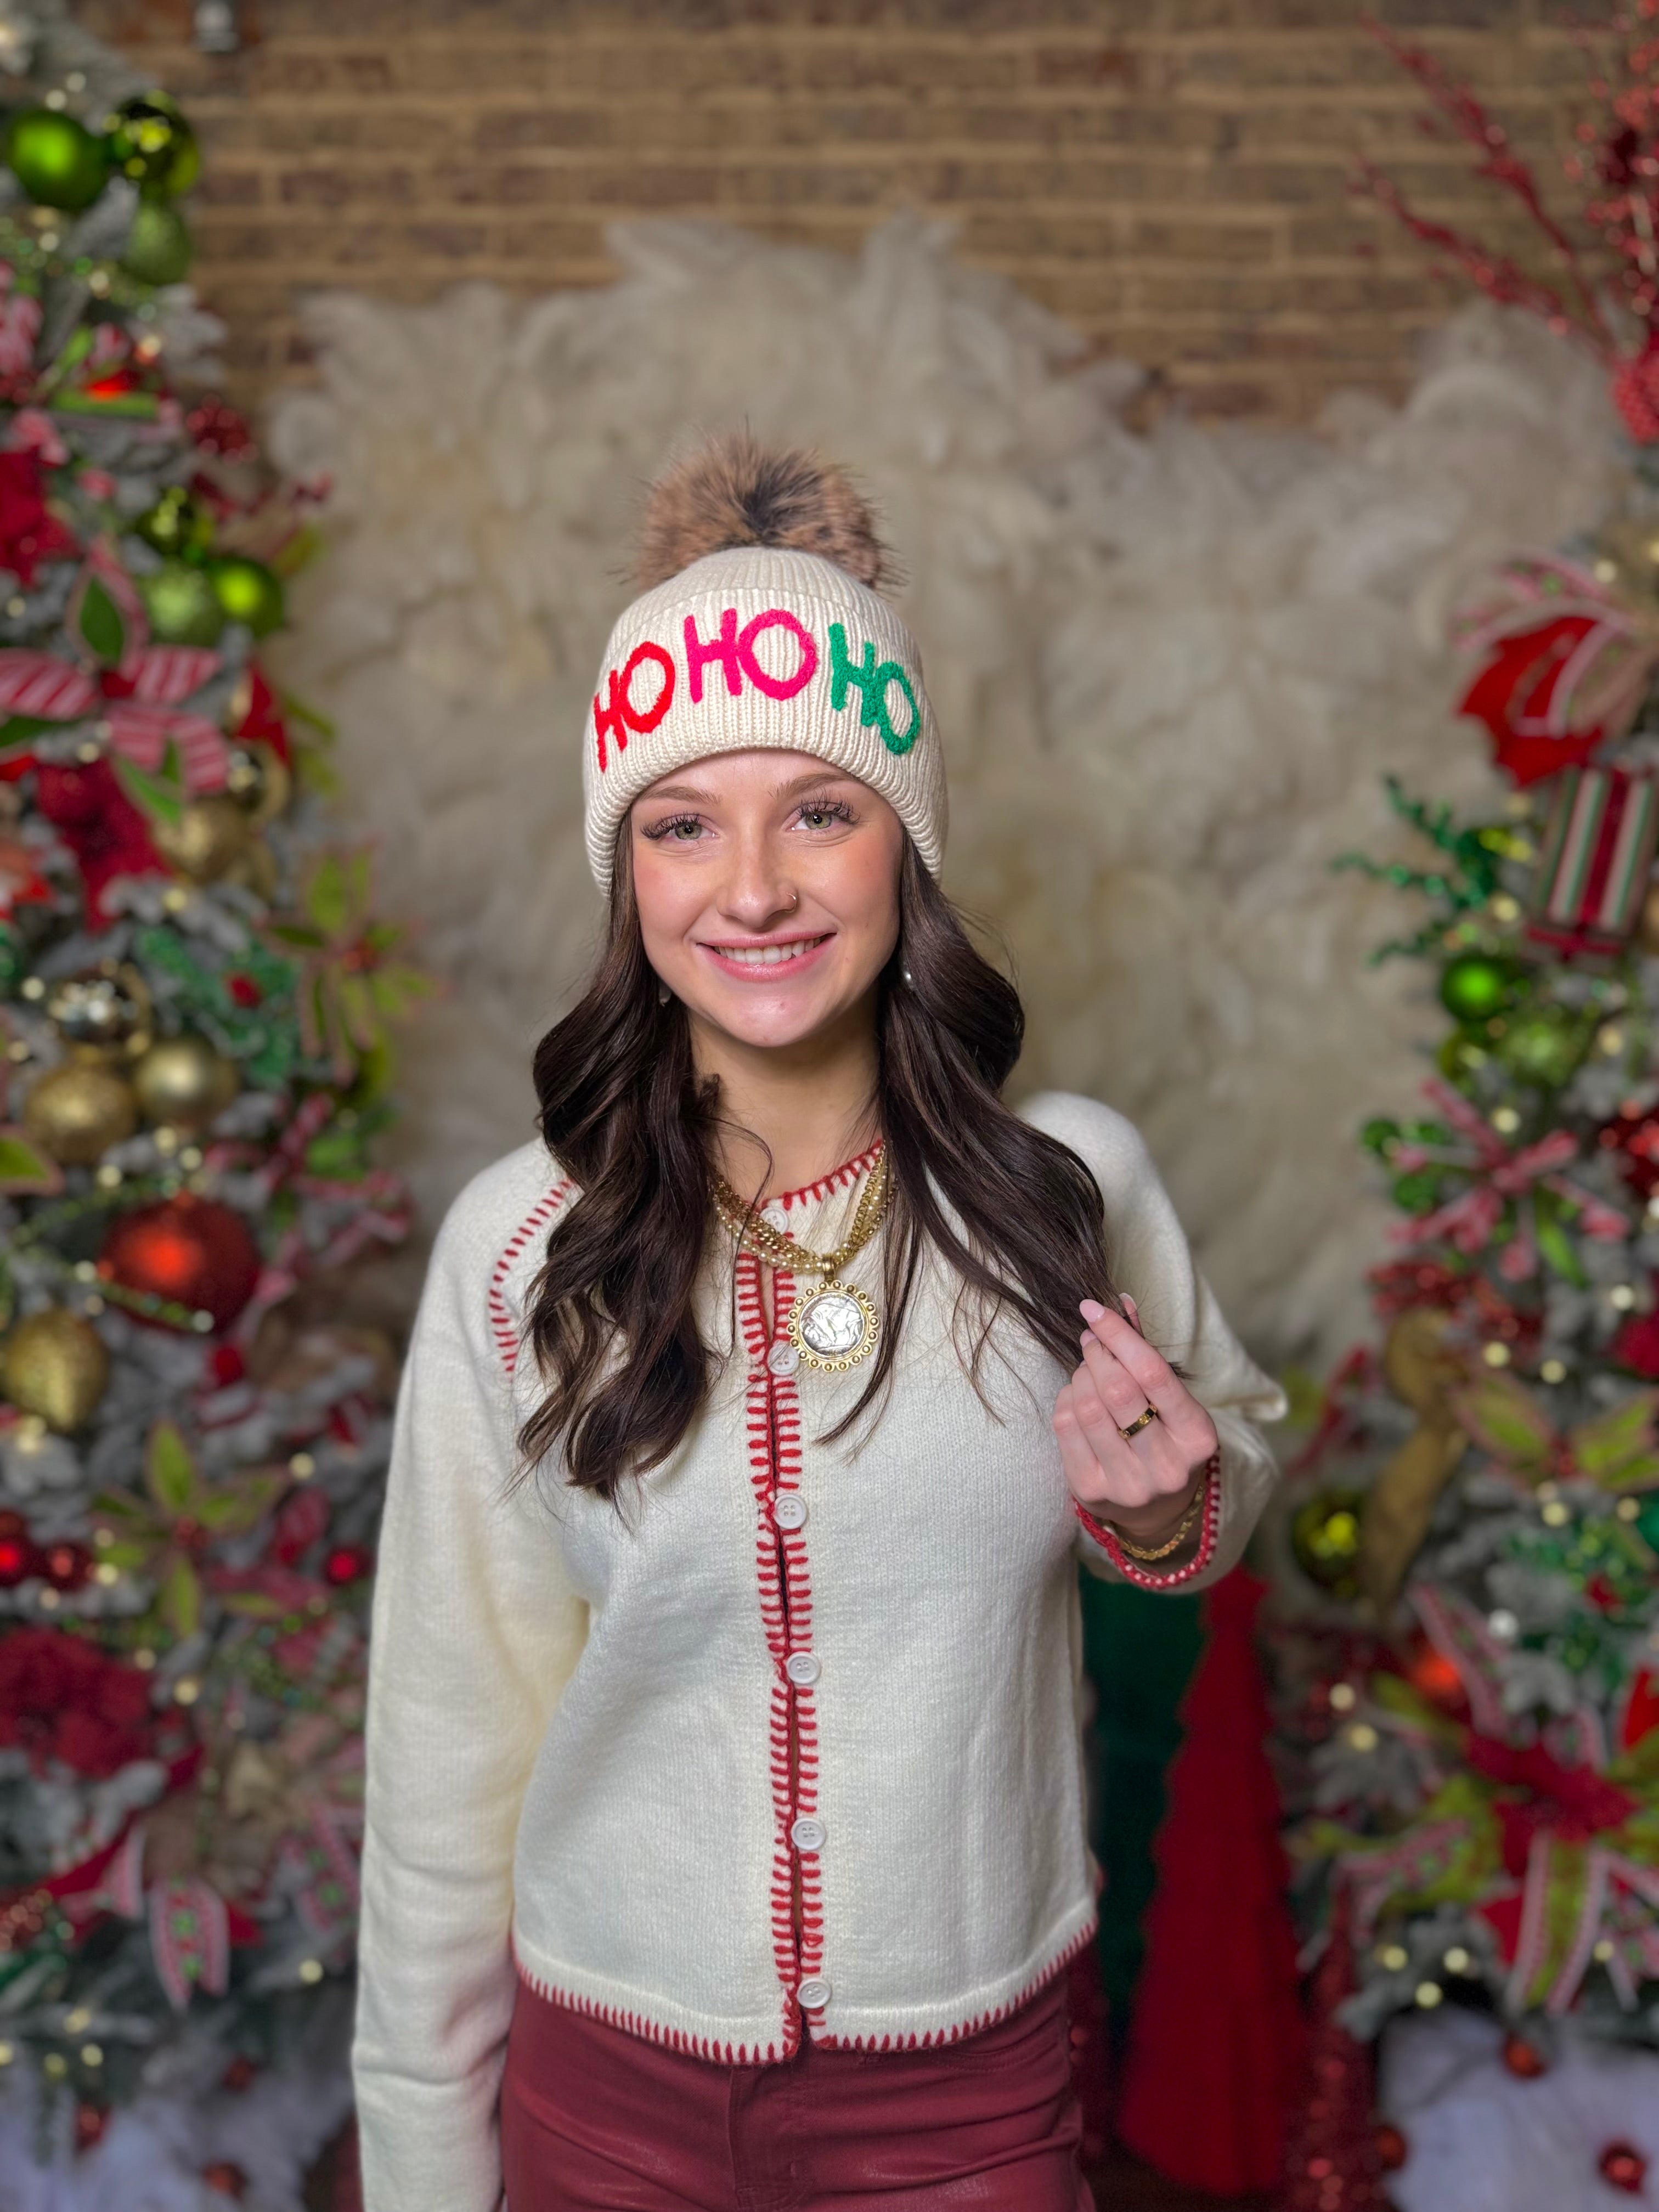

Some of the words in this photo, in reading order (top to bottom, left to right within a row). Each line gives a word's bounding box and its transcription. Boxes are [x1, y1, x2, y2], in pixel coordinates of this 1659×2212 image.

[594, 641, 675, 772] HO
[684, 608, 818, 703] HO
[829, 623, 920, 755] HO
